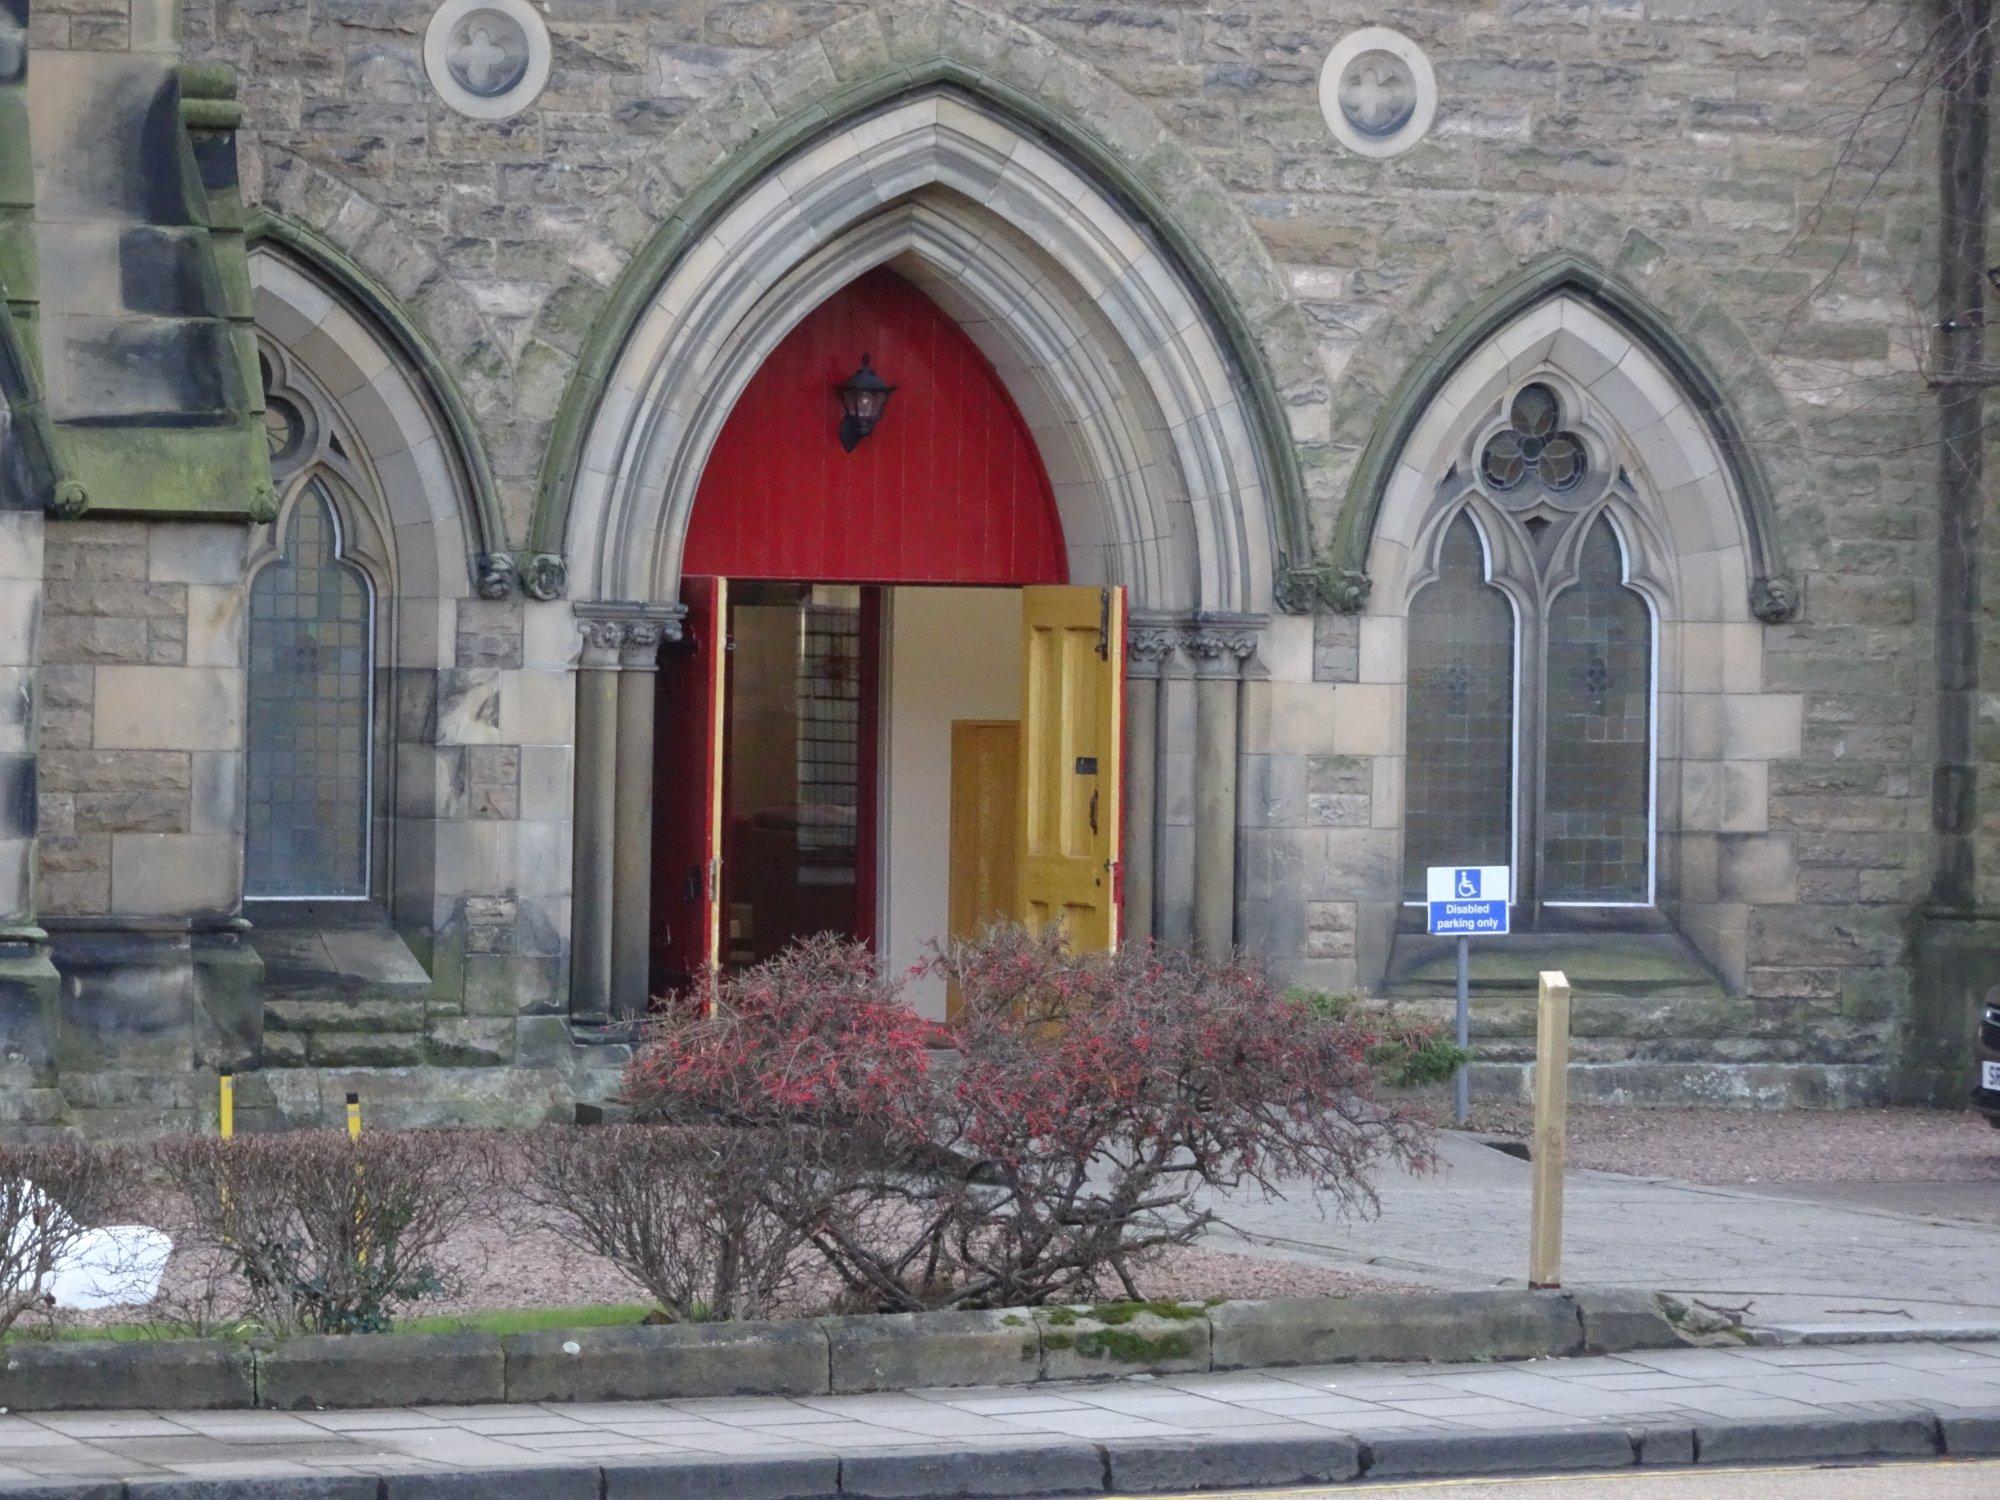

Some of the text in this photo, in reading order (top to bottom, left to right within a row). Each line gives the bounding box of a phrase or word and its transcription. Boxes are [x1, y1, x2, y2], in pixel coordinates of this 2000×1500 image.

[1446, 904, 1490, 914] Disabled
[1437, 917, 1499, 930] parking only
